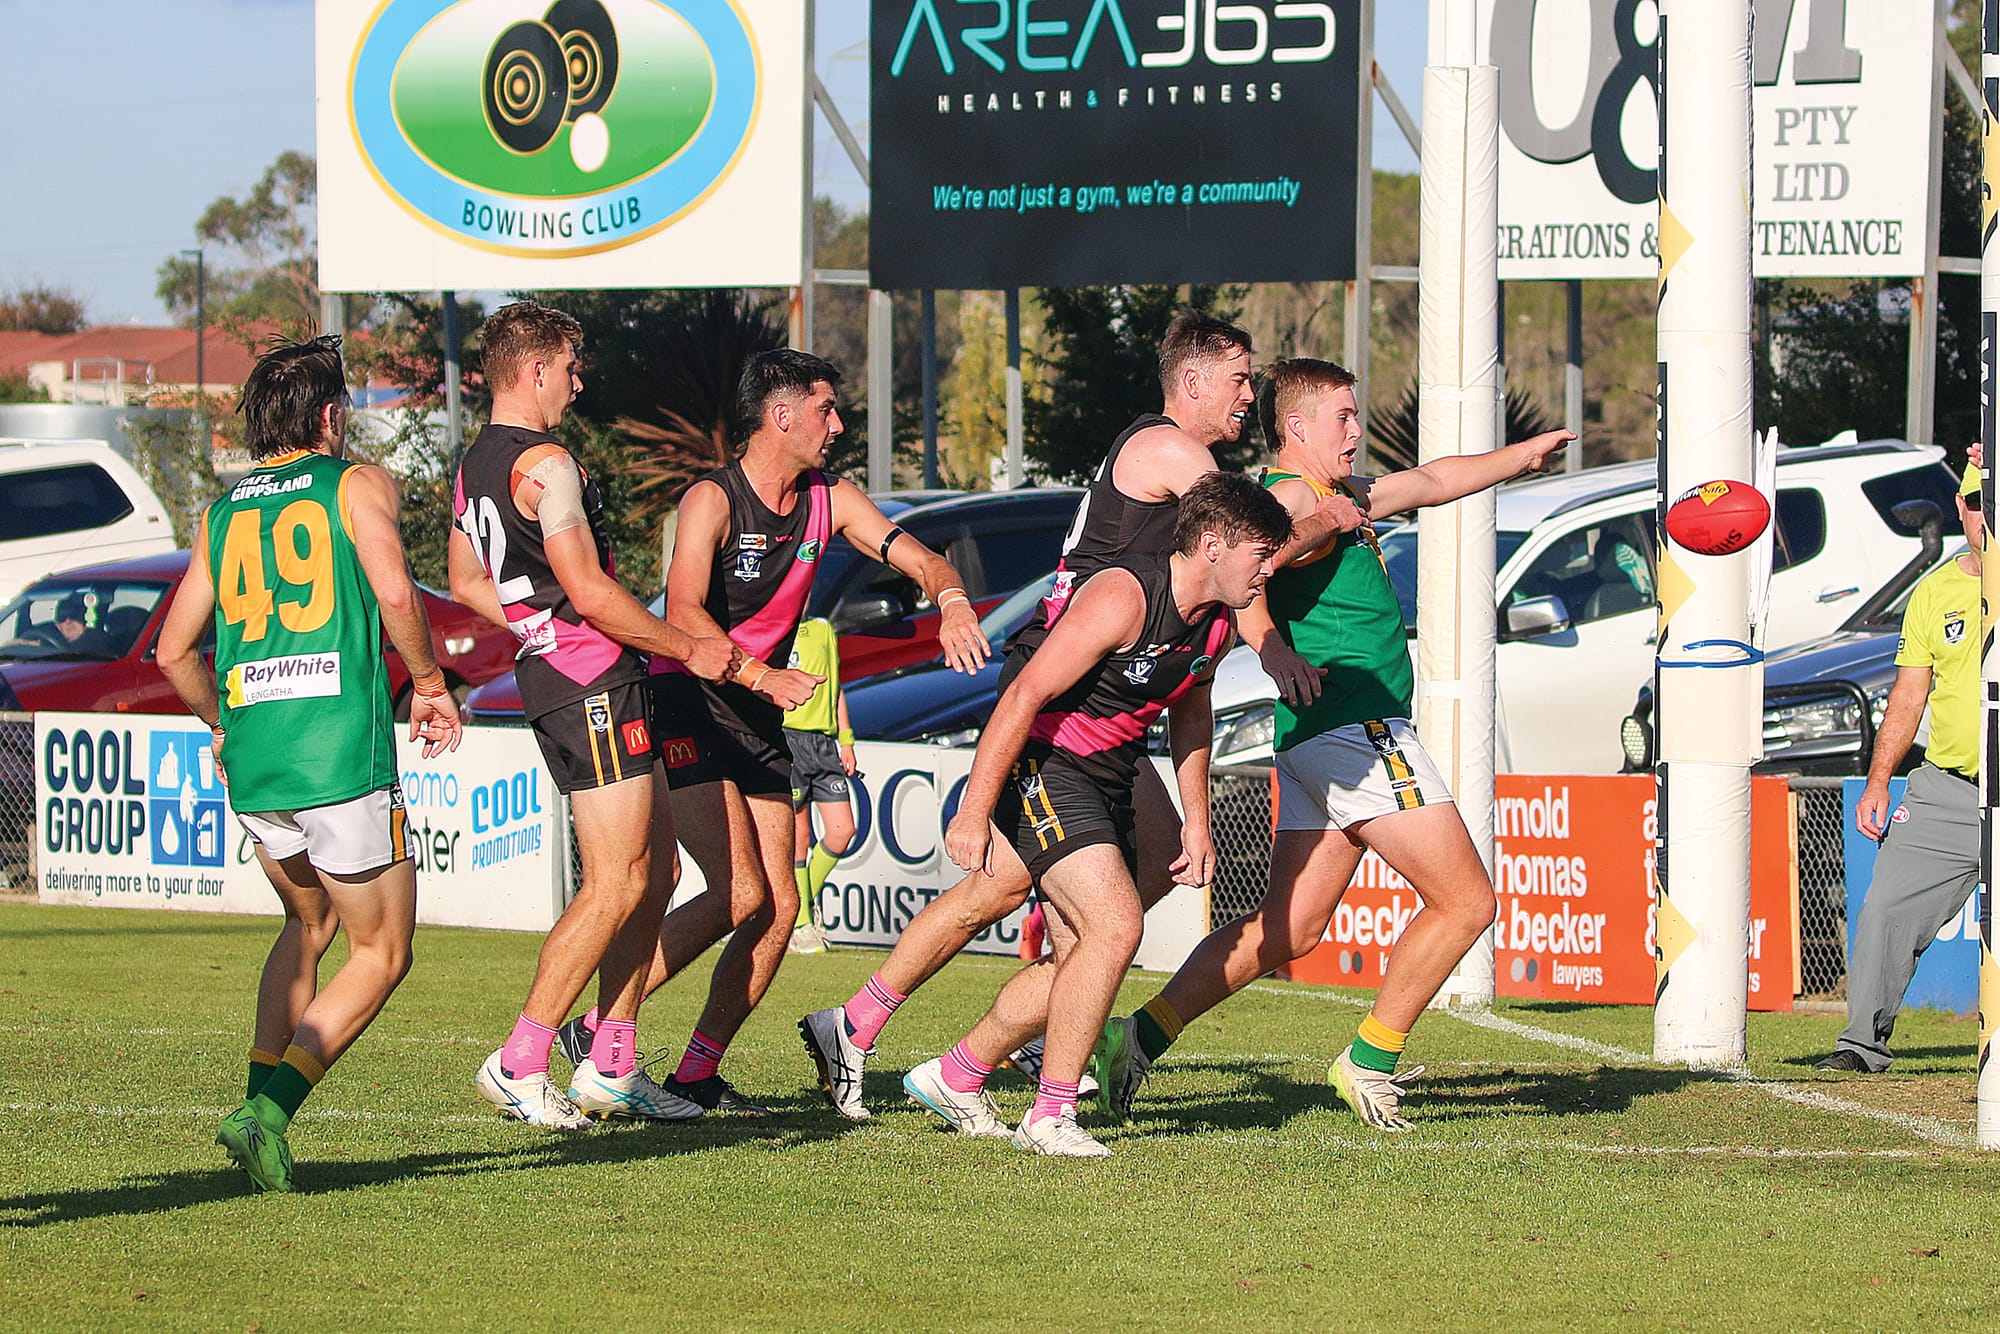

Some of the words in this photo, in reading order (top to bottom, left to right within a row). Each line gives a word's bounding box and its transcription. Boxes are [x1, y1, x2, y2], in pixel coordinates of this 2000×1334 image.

[938, 90, 1072, 113] HEALTH
[1118, 82, 1283, 107] FITNESS
[1774, 105, 1858, 146] PTY
[933, 184, 983, 210] We're
[988, 185, 1016, 208] not
[1016, 182, 1055, 214] just
[1059, 187, 1073, 207] a
[1076, 185, 1121, 213] gym,
[1126, 180, 1177, 205] we're
[1181, 184, 1195, 204] a
[1199, 176, 1301, 207] community
[1772, 161, 1850, 202] LTD
[462, 199, 573, 239] BOWLING
[582, 196, 641, 236] CLUB
[1755, 218, 1903, 256] TENANCE
[230, 473, 313, 502] GIPPSLAND
[237, 474, 275, 487] TAFE
[219, 499, 335, 642] 49
[460, 495, 536, 605] 12
[44, 727, 145, 796] COOL
[470, 767, 542, 835] COOL
[46, 796, 145, 856] GROUP
[471, 823, 542, 872] PROMOTIONS
[45, 867, 102, 897] delivering
[105, 874, 142, 893] more
[146, 872, 161, 893] to
[165, 876, 193, 899] your
[196, 873, 224, 896] door
[1495, 842, 1588, 898] homas
[1510, 898, 1607, 955] becker
[1552, 960, 1604, 992] lawyers
